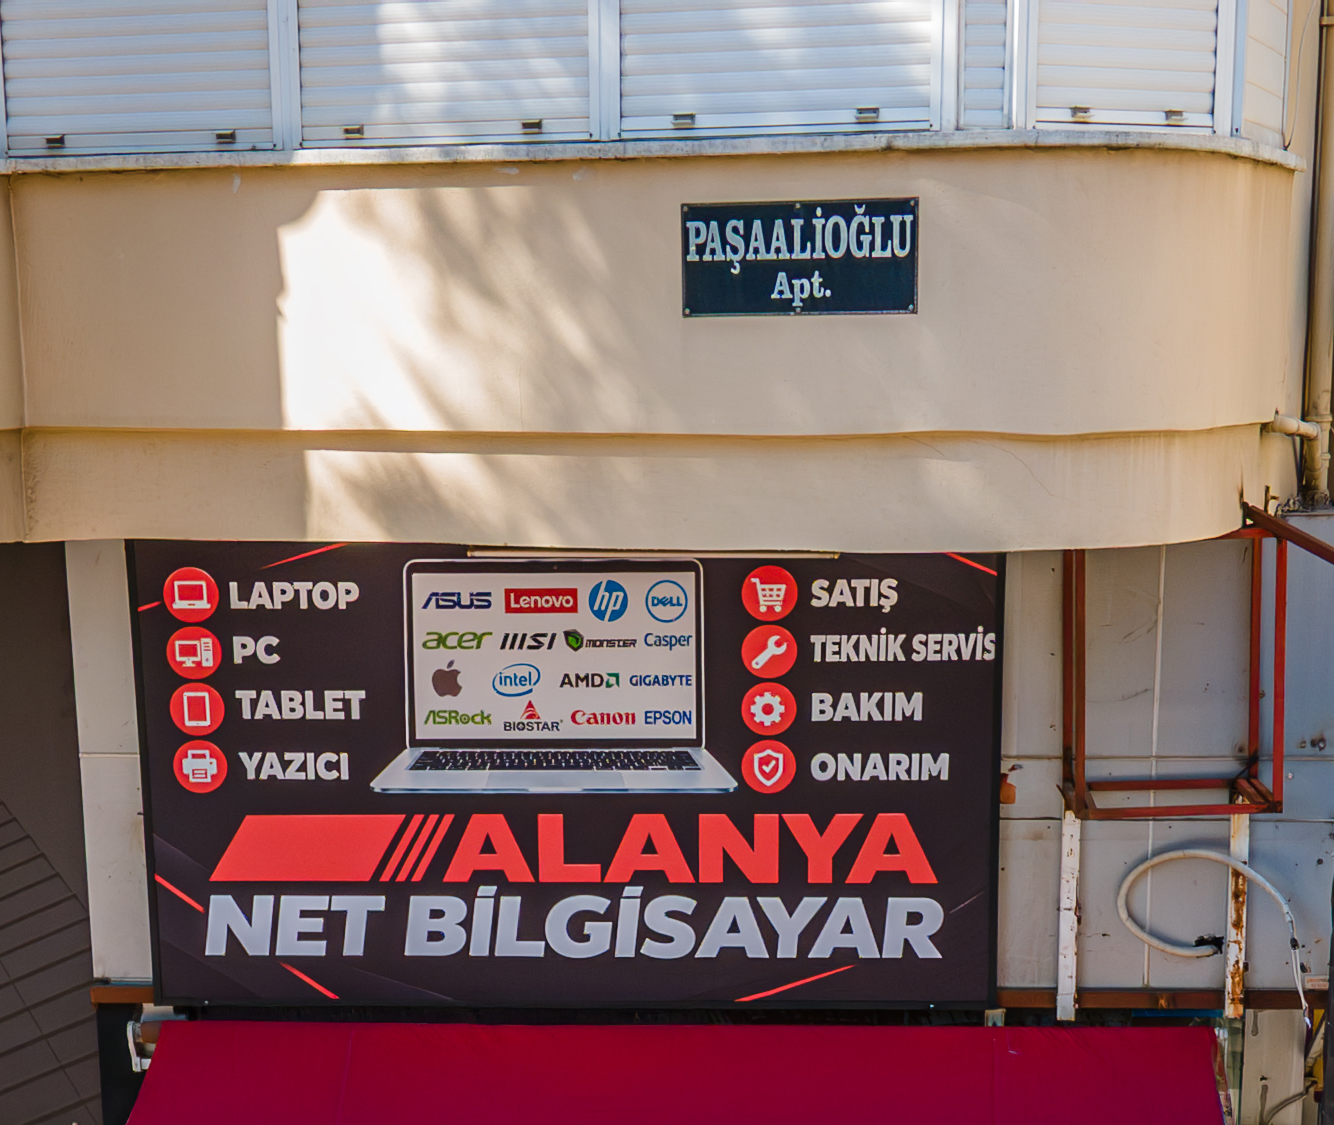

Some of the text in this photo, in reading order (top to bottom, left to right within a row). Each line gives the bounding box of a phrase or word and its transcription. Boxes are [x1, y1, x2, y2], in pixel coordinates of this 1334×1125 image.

[686, 204, 914, 274] PAŞAALİOĞLU
[771, 270, 831, 307] Apt.
[229, 581, 360, 610] LAPTOP
[421, 591, 493, 610] ASUS
[509, 592, 574, 609] Lenovo
[590, 580, 627, 622] hp
[651, 595, 683, 607] DELL
[810, 578, 898, 613] SATIŞ
[232, 635, 281, 665] PC
[421, 631, 493, 650] acer
[644, 633, 693, 651] Casper
[810, 625, 996, 662] TEKNİK SERVİS
[498, 671, 533, 687] intel
[559, 673, 604, 688] AMD
[629, 674, 692, 687] GIGABYTE
[235, 690, 366, 720] TABLET
[423, 710, 492, 726] ASRock
[570, 710, 636, 726] Canon
[644, 710, 692, 725] EPSON
[811, 692, 923, 722] BAKIM
[503, 721, 561, 732] BIOSTAR
[238, 752, 349, 780] YAZICI
[810, 753, 950, 781] ONARIM
[442, 812, 938, 884] ALANYA
[203, 885, 944, 959] NET BİLGİSAYAR
